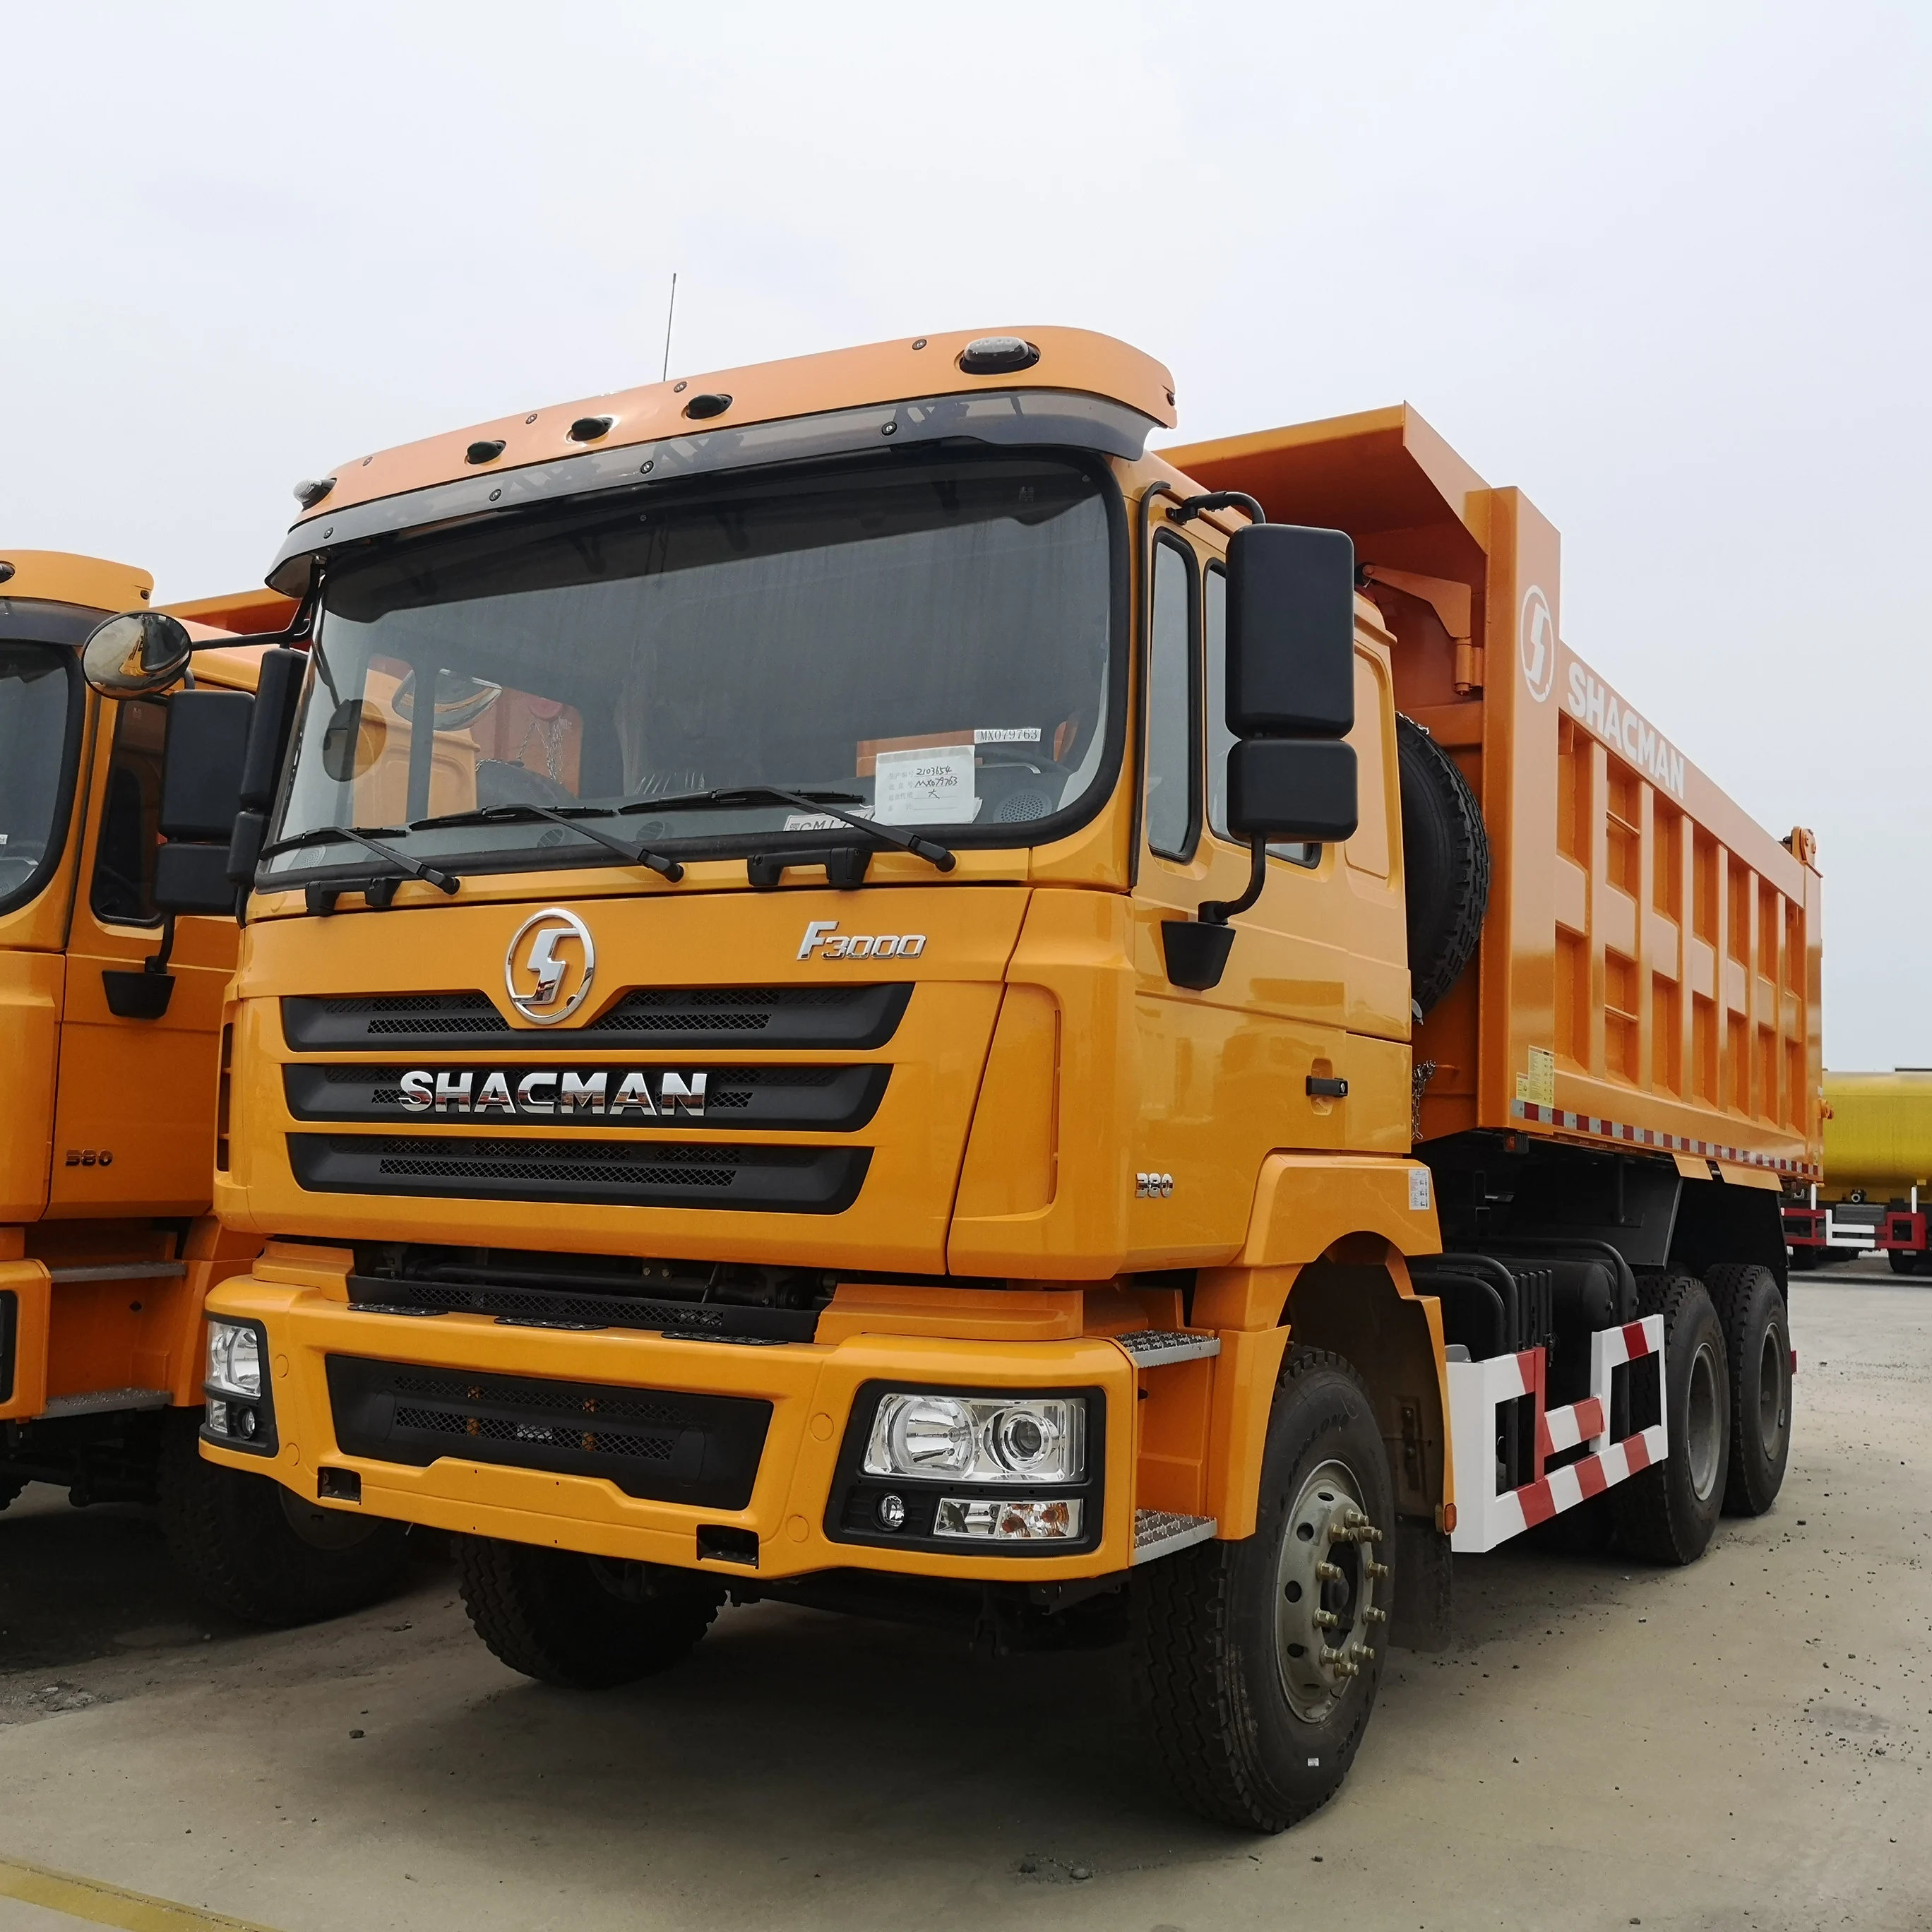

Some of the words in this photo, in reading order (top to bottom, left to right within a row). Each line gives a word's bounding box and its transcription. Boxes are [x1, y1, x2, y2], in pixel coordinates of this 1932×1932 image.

[980, 729, 1037, 741] MX079763
[1568, 662, 1684, 799] SHACMAN
[914, 776, 958, 787] MX079763
[916, 765, 952, 775] 2103654
[797, 921, 927, 960] F3000
[398, 1071, 708, 1116] SHACMAN
[1135, 1173, 1174, 1198] 380
